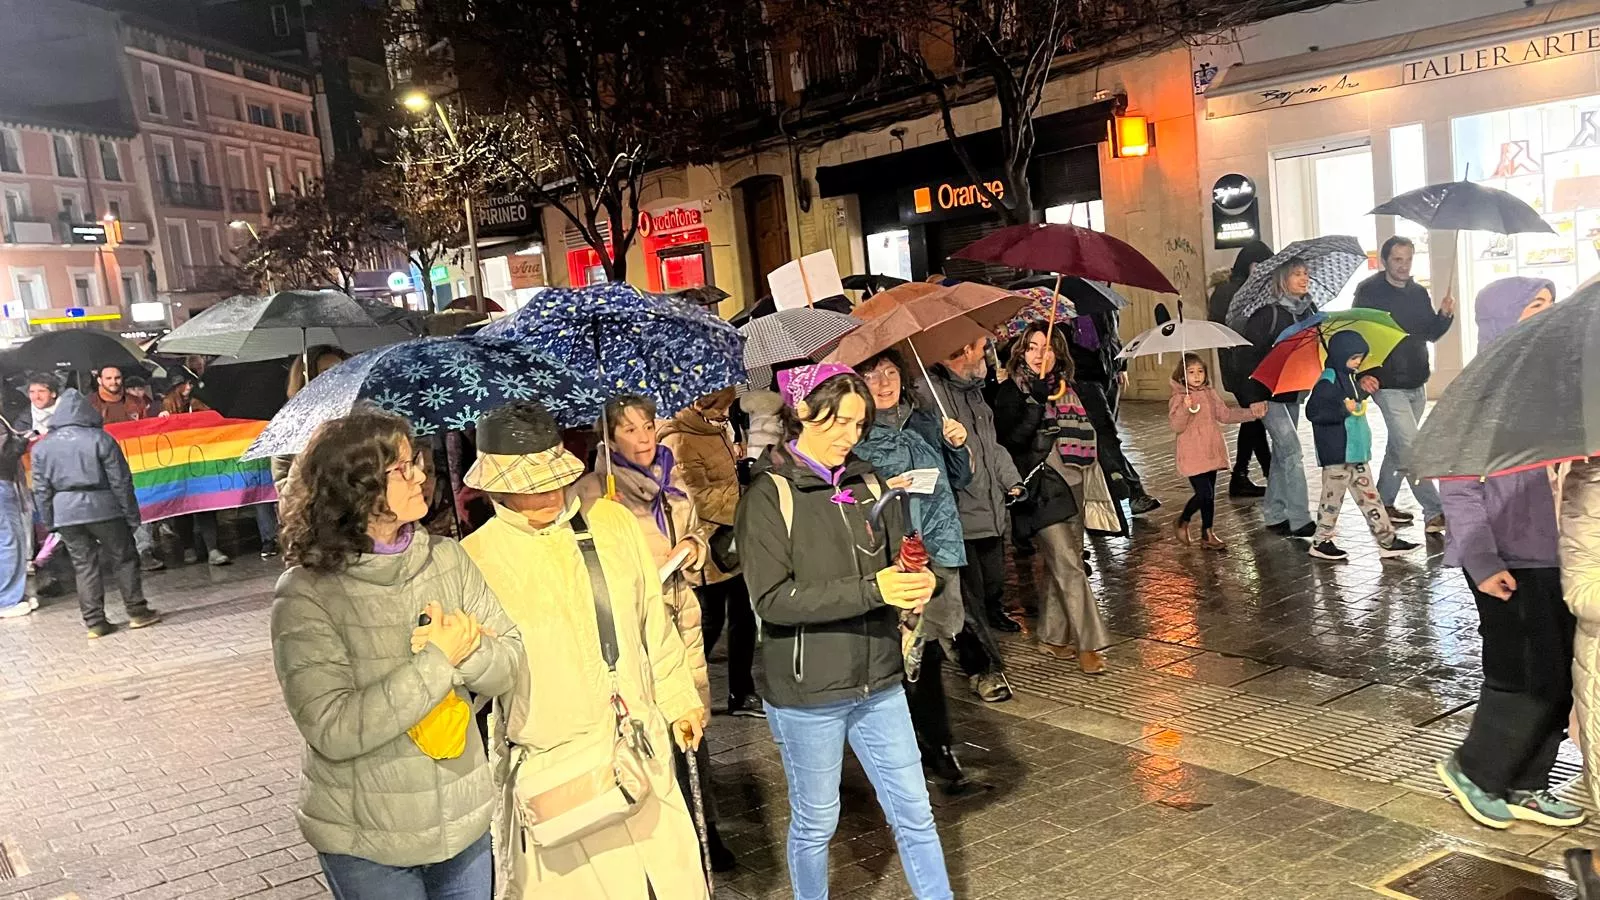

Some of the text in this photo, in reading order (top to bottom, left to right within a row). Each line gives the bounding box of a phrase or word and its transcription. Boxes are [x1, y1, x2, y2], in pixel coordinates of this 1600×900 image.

[1405, 27, 1600, 81] TALLER ARTE
[480, 204, 527, 226] PIRINEO
[652, 208, 699, 231] vodafone
